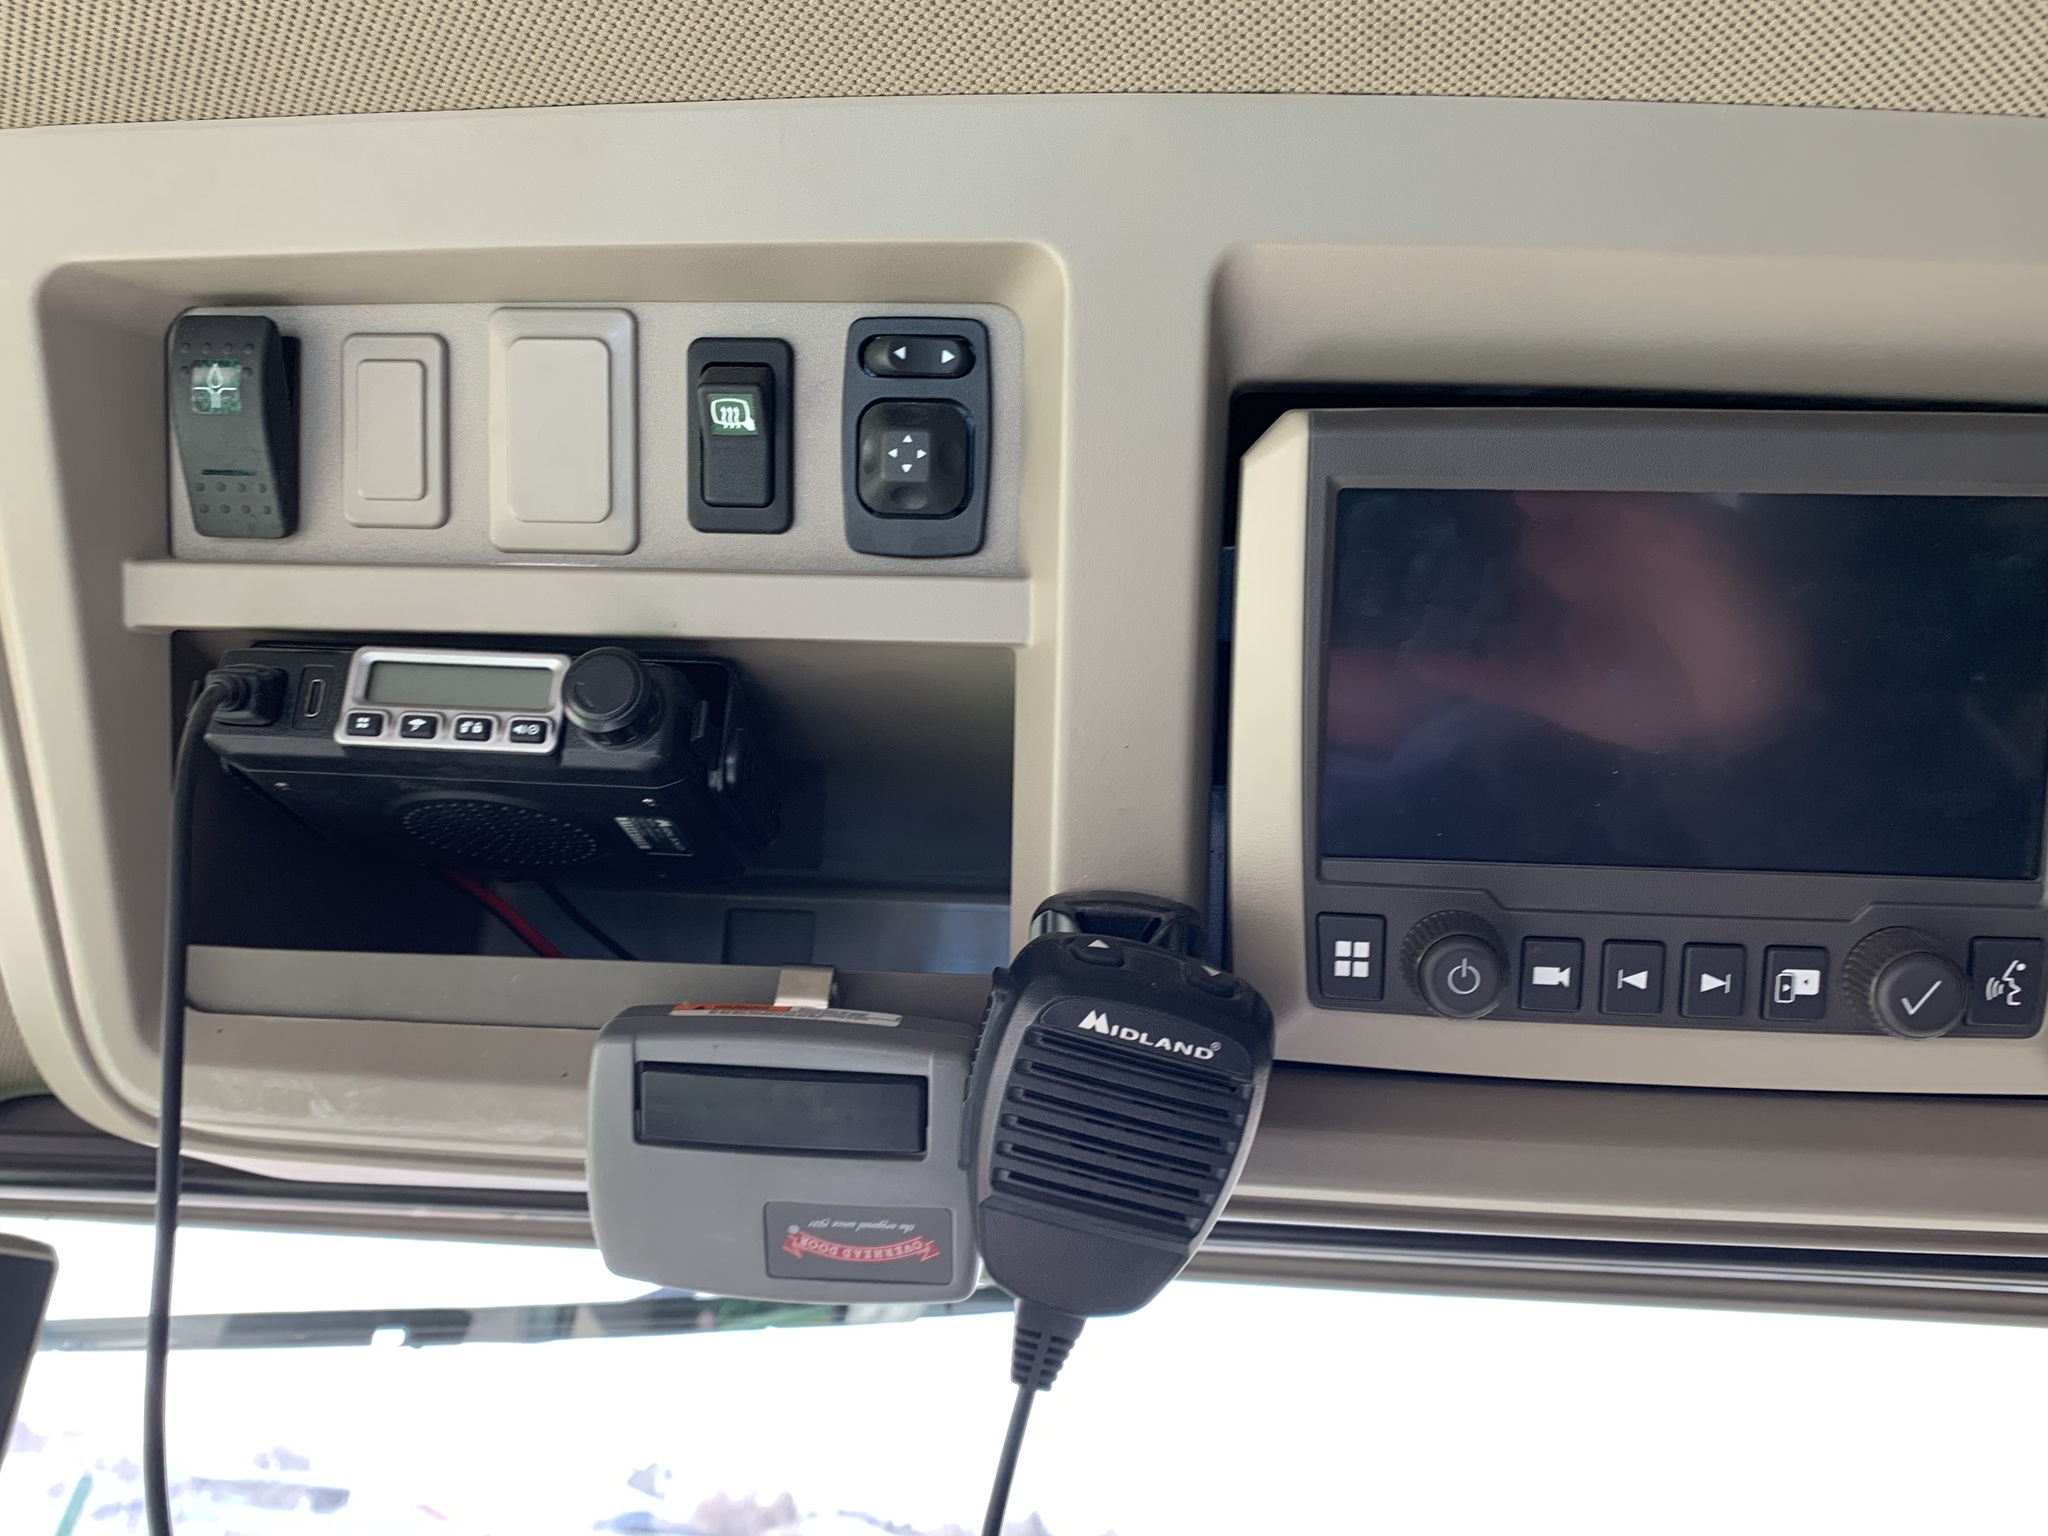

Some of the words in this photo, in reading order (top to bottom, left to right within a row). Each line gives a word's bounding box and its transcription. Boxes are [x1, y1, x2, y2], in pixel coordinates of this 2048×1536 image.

[1077, 1009, 1215, 1060] MIDLAND
[855, 1219, 897, 1231] original
[899, 1223, 916, 1233] the
[798, 1237, 839, 1256] DOOR
[842, 1240, 923, 1260] OVERHEAD
